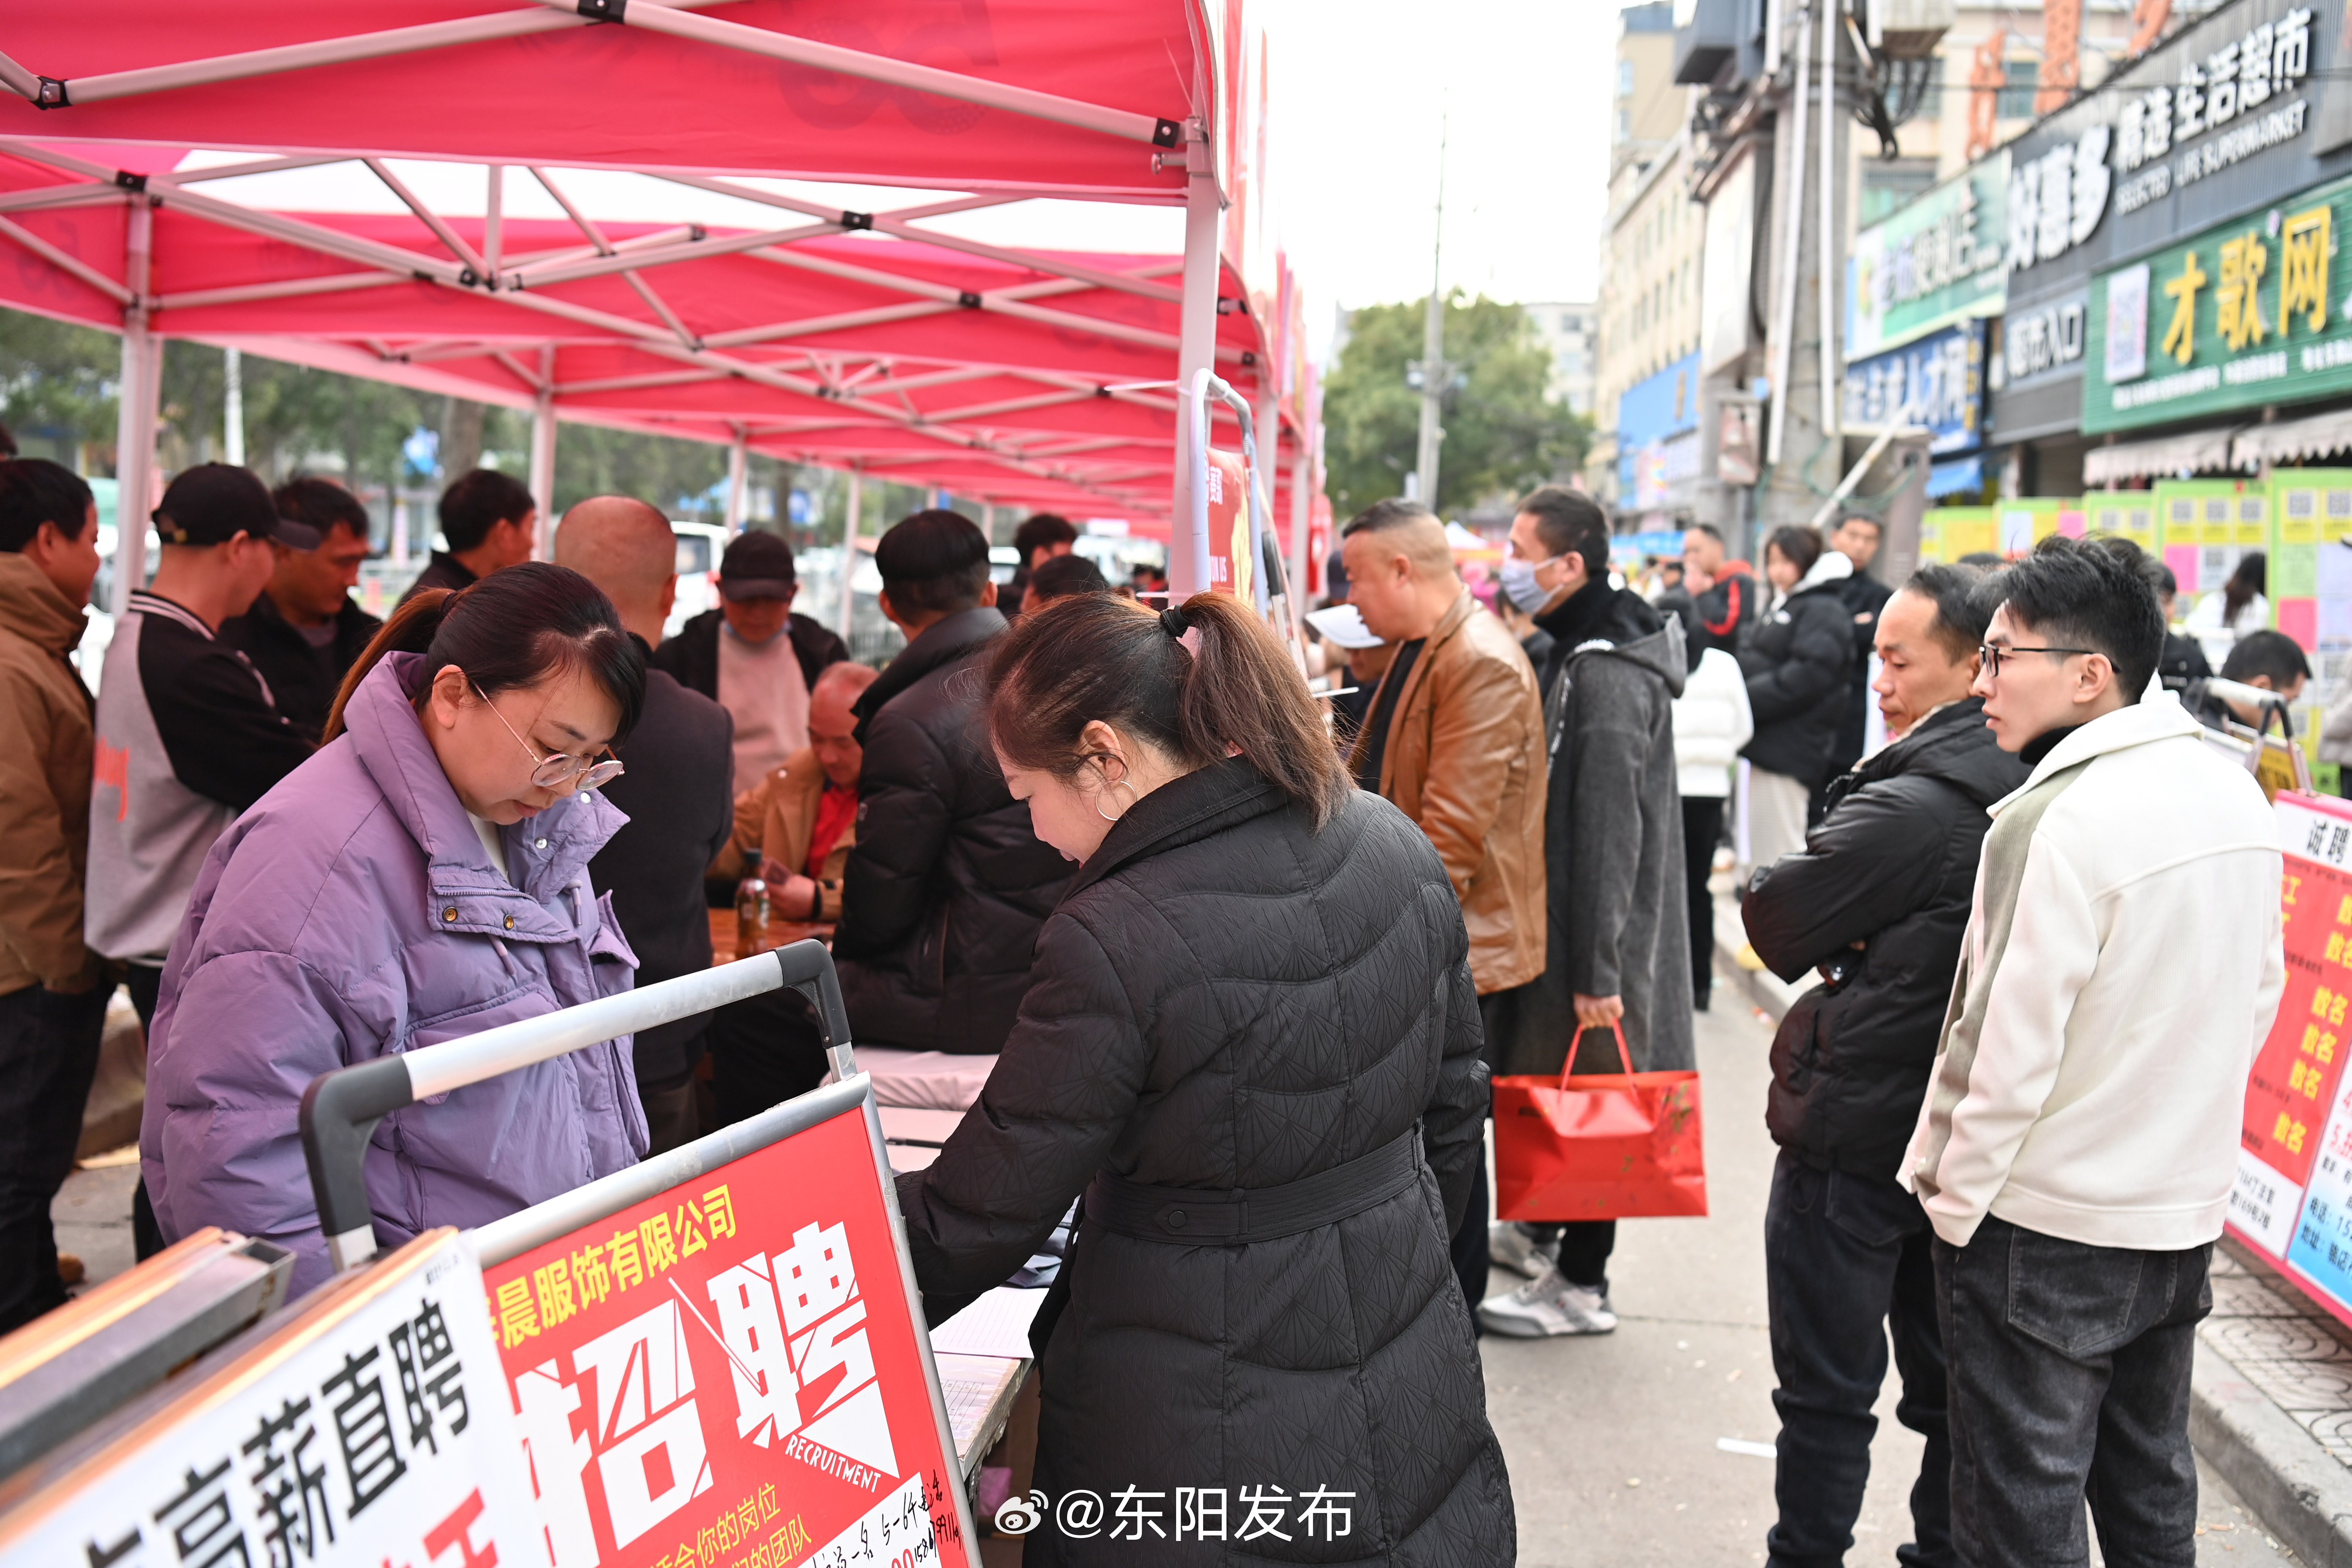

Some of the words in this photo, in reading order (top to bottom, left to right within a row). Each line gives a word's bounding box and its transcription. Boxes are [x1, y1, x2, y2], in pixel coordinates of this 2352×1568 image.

[2162, 206, 2330, 365] 才歌网
[487, 1184, 736, 1349] 晨服饰有限公司
[514, 1221, 900, 1568] 招聘
[785, 1435, 881, 1493] RECRUITMENT
[731, 1514, 812, 1568] 的团队
